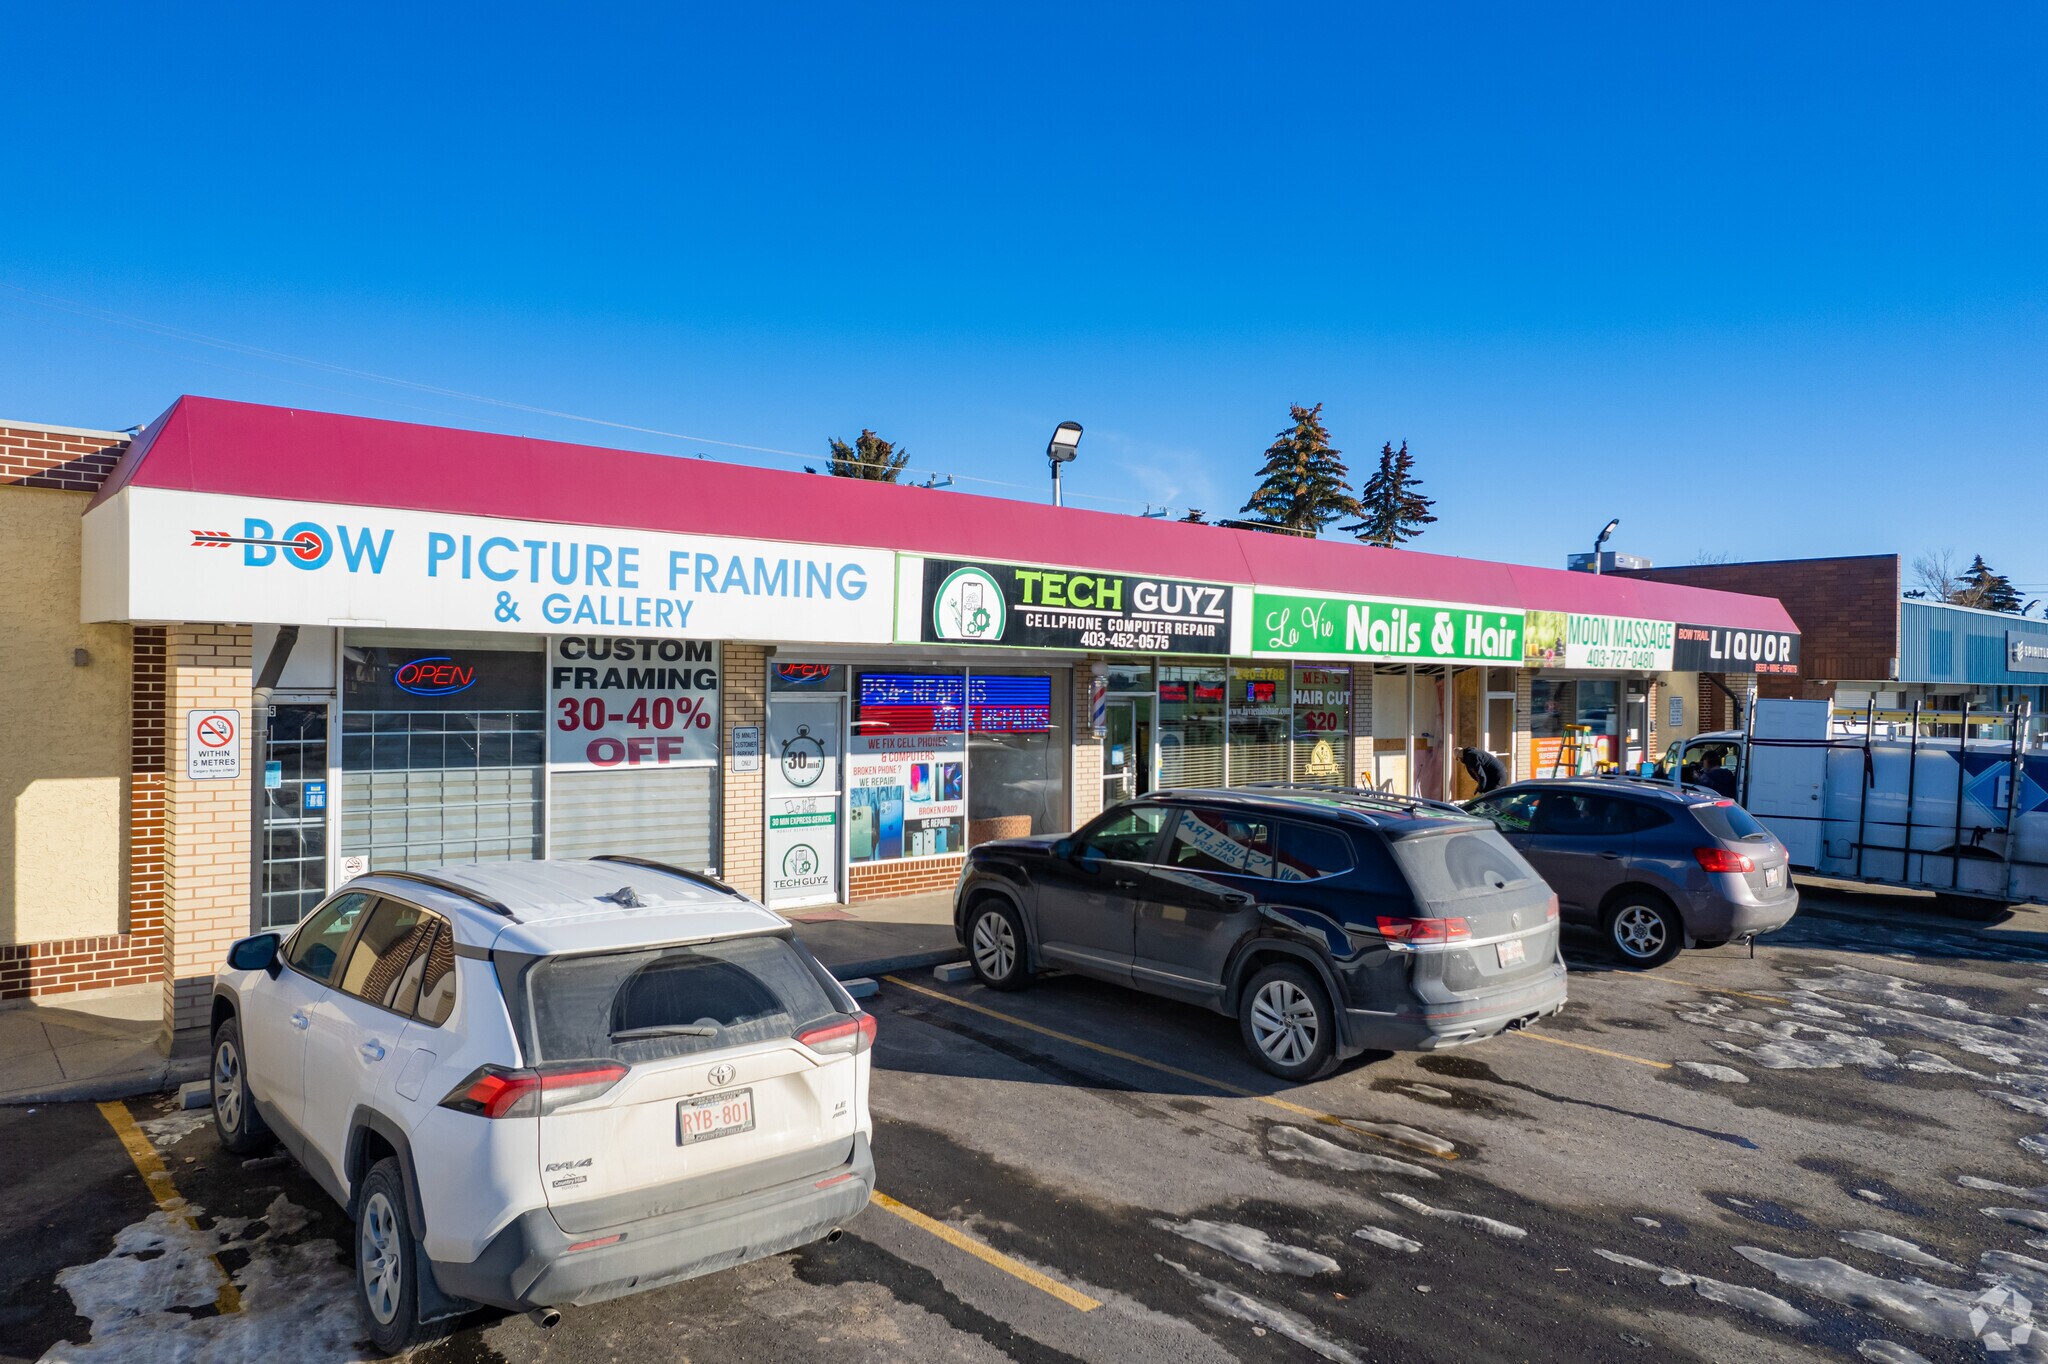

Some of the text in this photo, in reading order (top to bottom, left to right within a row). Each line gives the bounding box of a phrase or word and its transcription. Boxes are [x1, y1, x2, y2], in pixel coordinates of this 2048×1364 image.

[243, 517, 867, 601] BOW PICTURE FRAMING
[1015, 569, 1225, 617] TECH GUYZ
[494, 590, 694, 628] & GALLERY
[1025, 613, 1216, 637] CELLPHONE COMPUTER REPAIR
[1266, 602, 1517, 658] La Vie Nails & Hair
[1567, 615, 1671, 650] MOON MASSAGE
[1678, 628, 1710, 641] BOW TRAIL
[559, 636, 713, 662] CUSTOM
[1080, 631, 1170, 650] 403-452-0575
[1710, 629, 1791, 662] LIQUOR
[1586, 649, 1655, 669] 403-727-0480
[398, 664, 474, 685] OPEN
[552, 666, 717, 690] FRAMING
[1302, 671, 1342, 684] MENS
[1293, 689, 1324, 705] HAIR
[1326, 690, 1351, 705] CUT
[557, 696, 711, 732] 30-40%
[1304, 710, 1338, 732] $20
[741, 731, 757, 739] MINUTE
[867, 736, 948, 749] WE FIX CELL PHONES
[586, 736, 684, 767] OFF
[788, 751, 807, 769] 30
[888, 750, 935, 762] COMPUTERS
[853, 766, 877, 775] BROKEN
[877, 765, 897, 774] PHONE
[859, 776, 896, 786] WE REPAIR!
[918, 806, 941, 815] BROKEN
[772, 817, 779, 826] 30
[780, 817, 790, 826] MIN
[921, 819, 930, 828] WE
[773, 876, 828, 888] TECH GUYZ
[683, 1101, 749, 1134] RYB-801
[545, 1158, 593, 1172] RAV4
